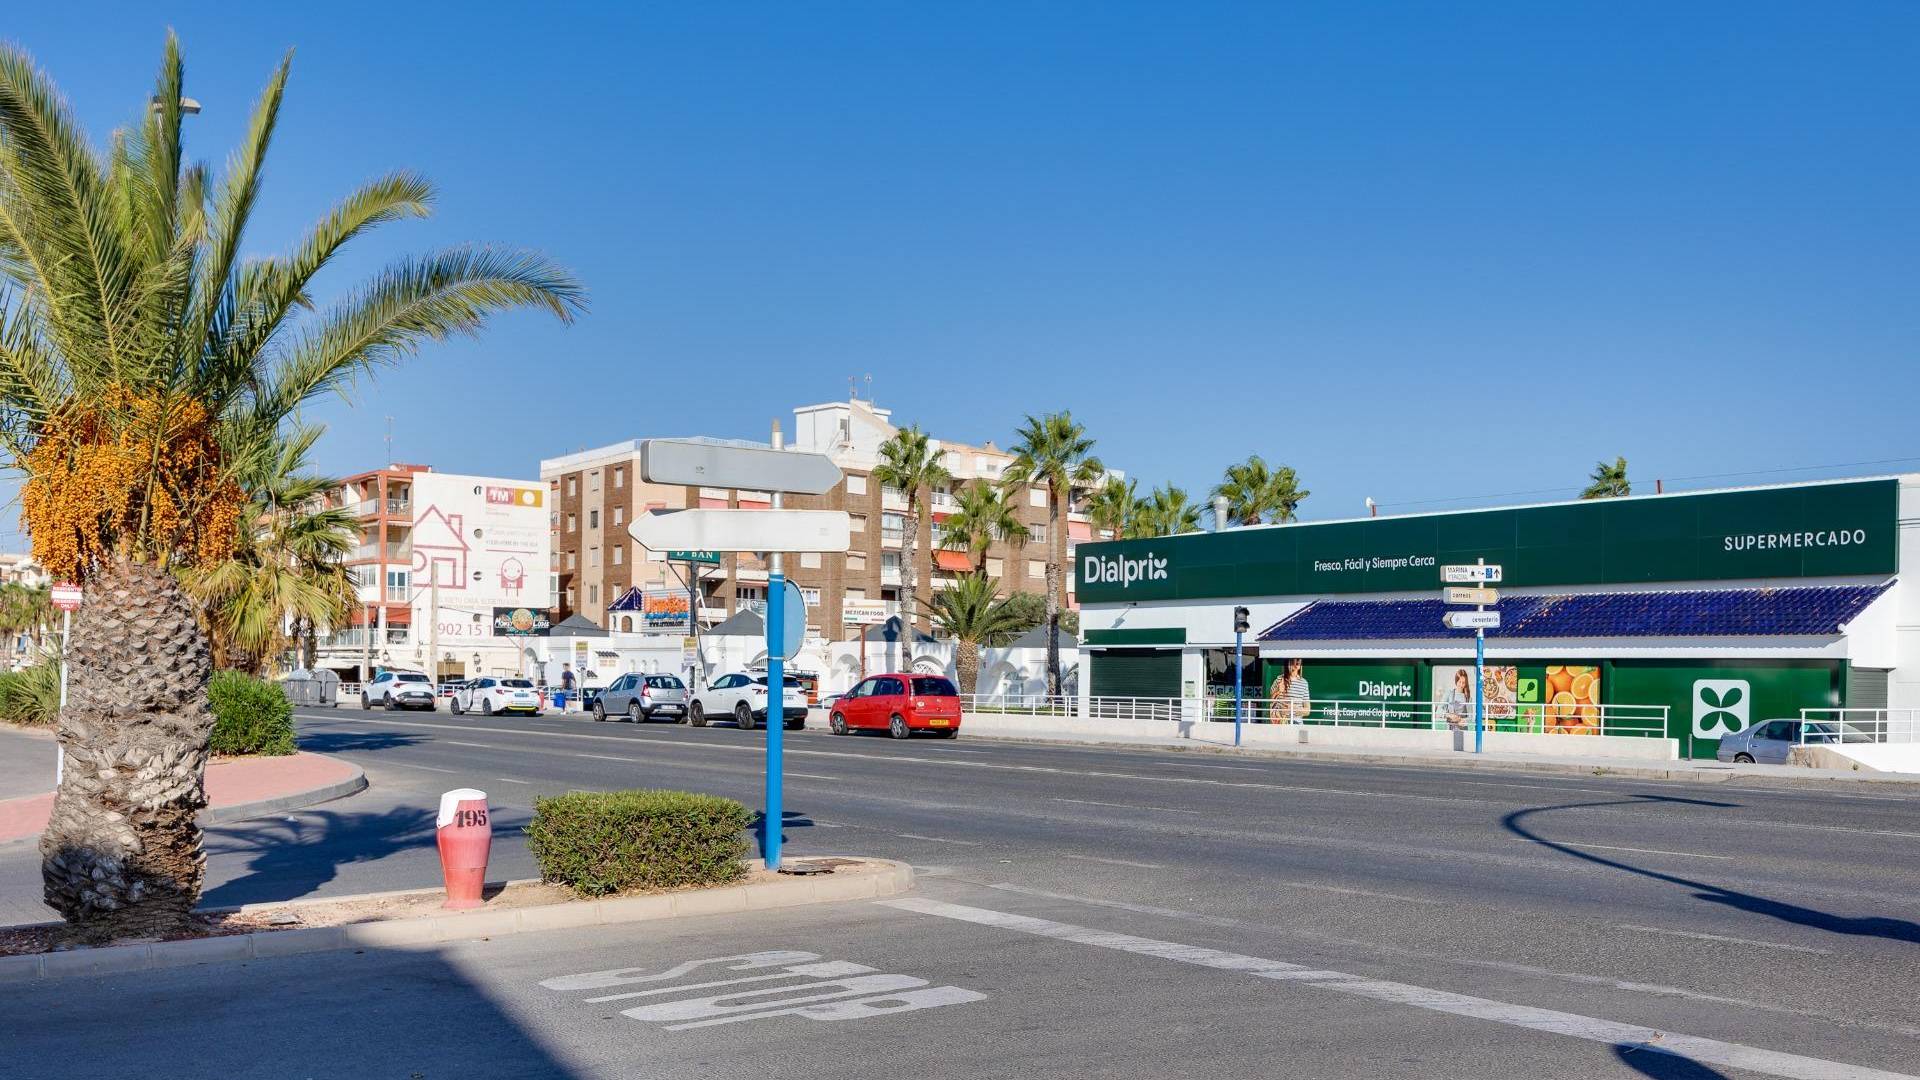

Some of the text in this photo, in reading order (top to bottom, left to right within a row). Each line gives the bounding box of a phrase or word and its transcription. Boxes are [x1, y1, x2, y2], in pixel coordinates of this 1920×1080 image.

[1724, 529, 1866, 551] SUPERMERCADO
[1084, 552, 1168, 588] Dialprix
[1314, 555, 1435, 572] Fresco, Fácil y Siempre Cerca
[438, 623, 462, 636] 902
[468, 624, 482, 636] 15
[1359, 681, 1411, 700] Dialprix
[1323, 707, 1411, 720] Fres, Easy and Cloe to you
[456, 810, 487, 828] 195
[538, 950, 988, 1031] STOP
